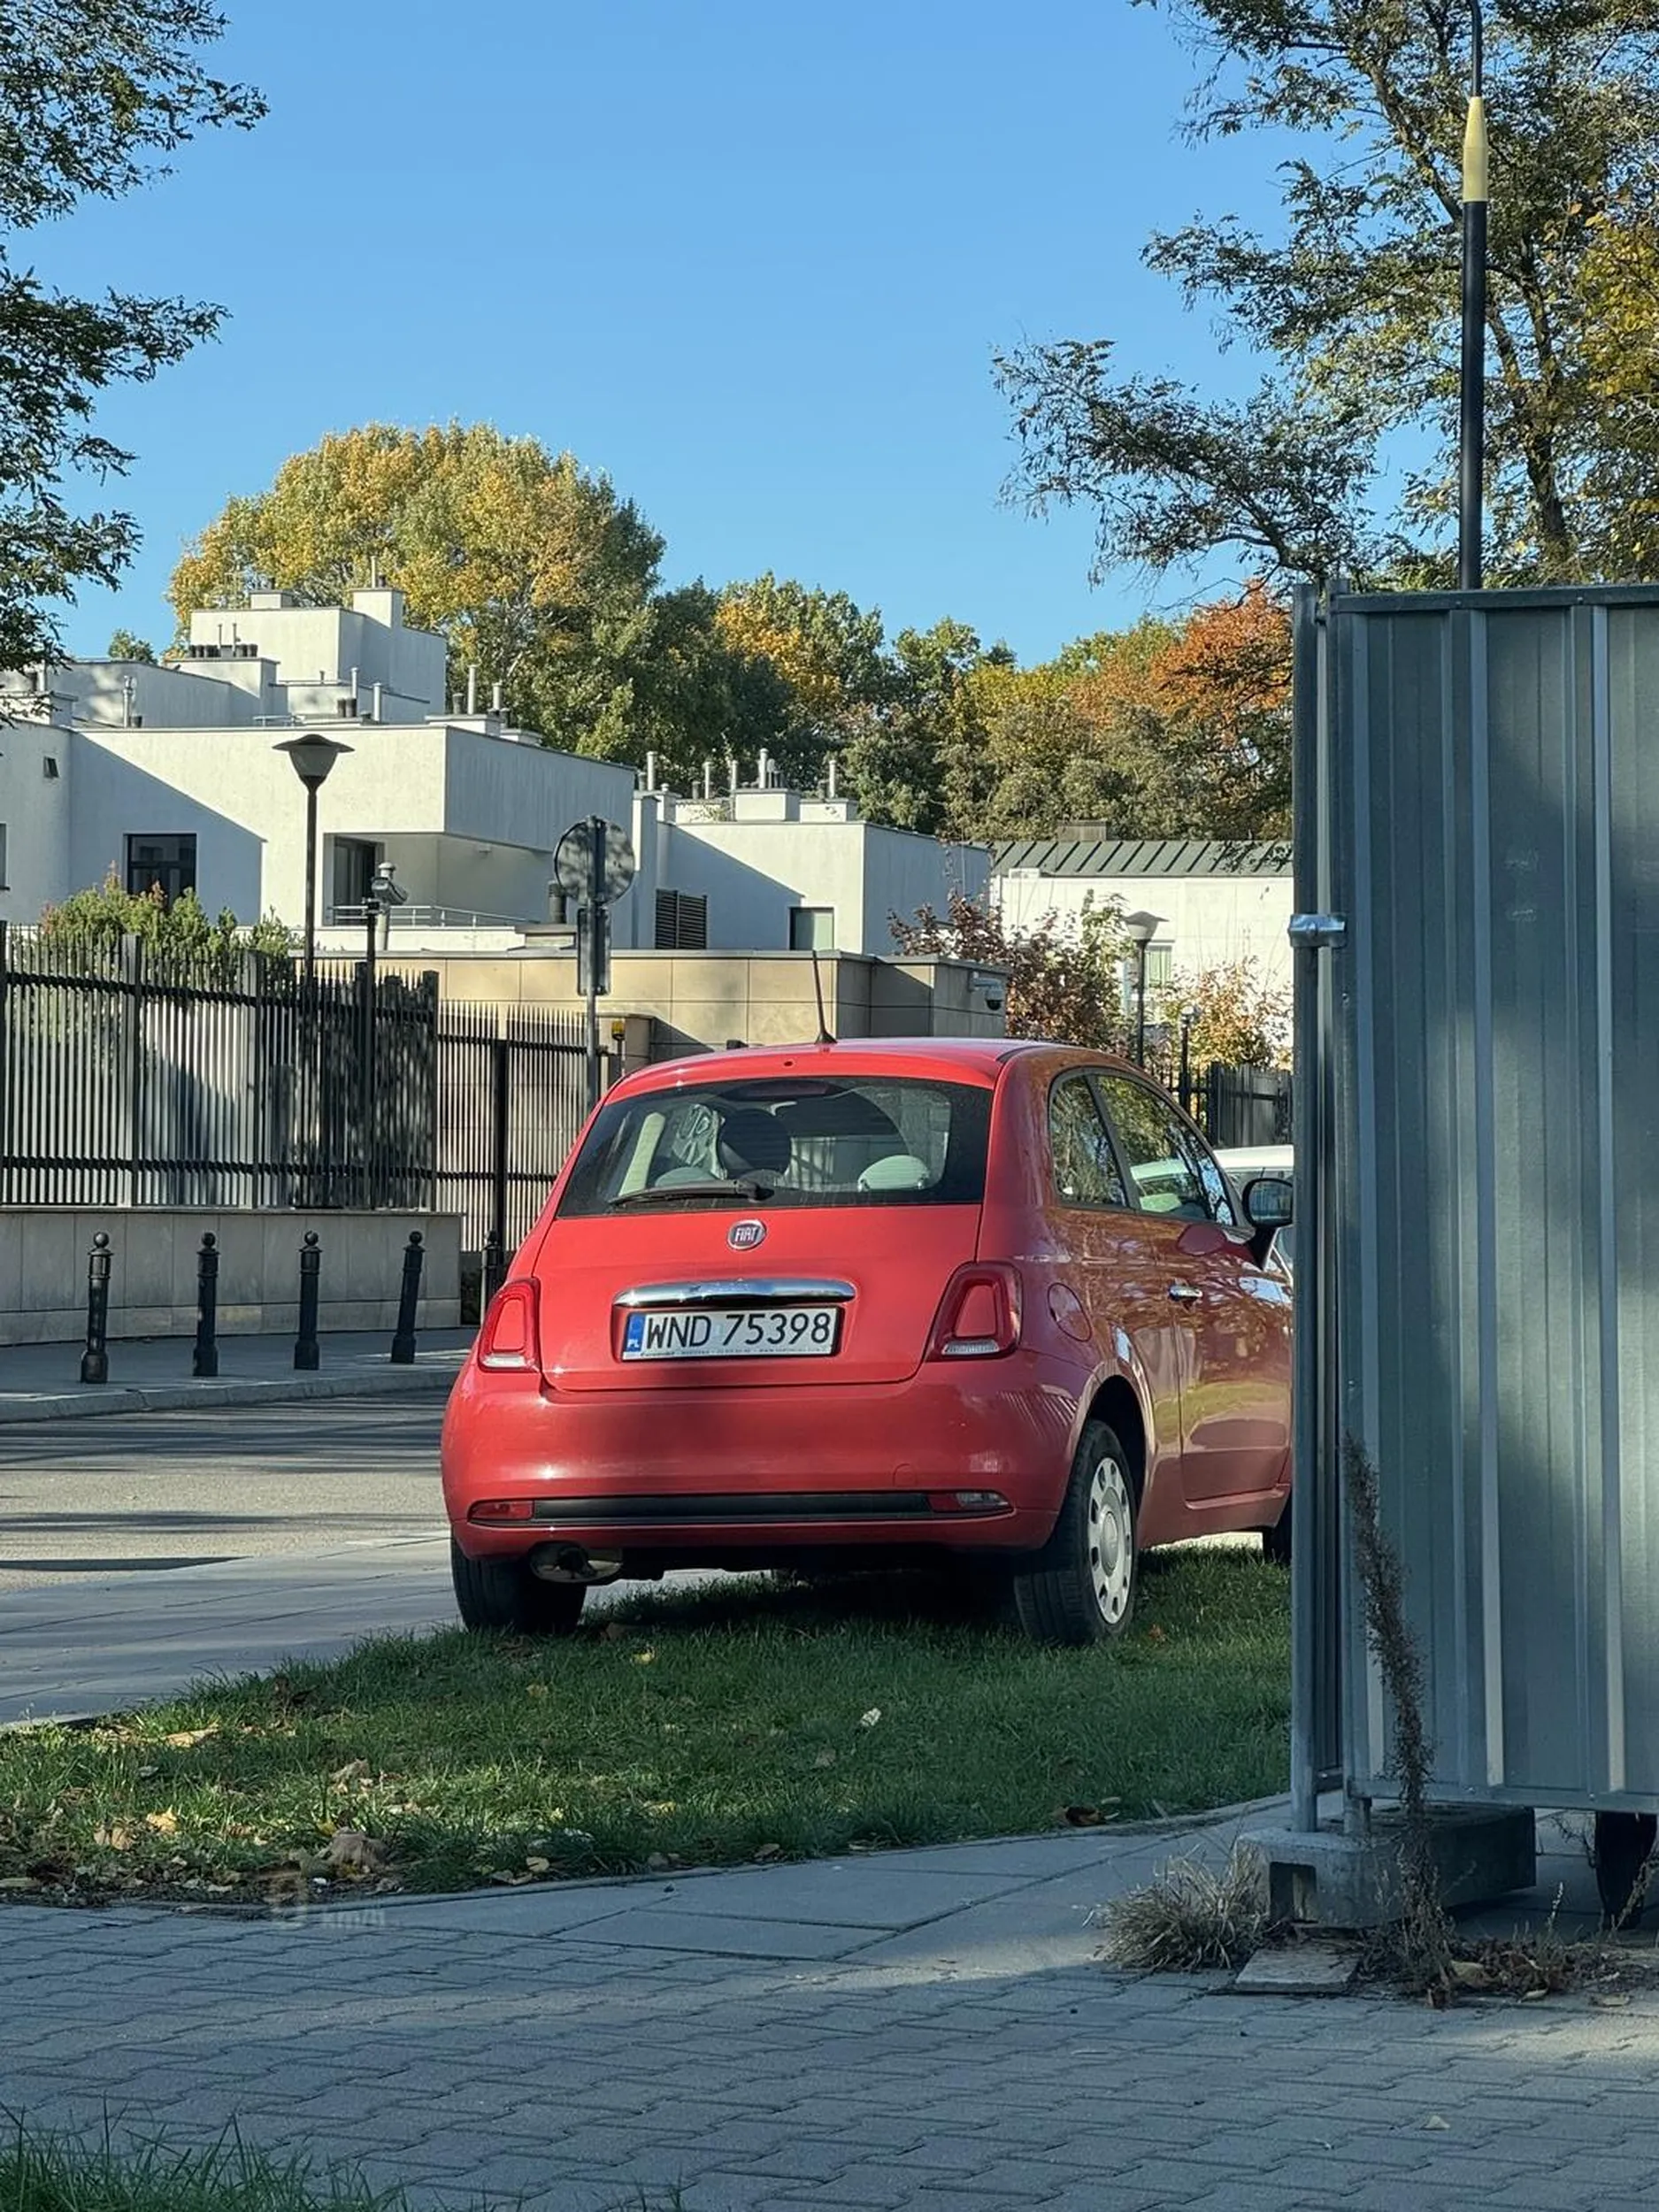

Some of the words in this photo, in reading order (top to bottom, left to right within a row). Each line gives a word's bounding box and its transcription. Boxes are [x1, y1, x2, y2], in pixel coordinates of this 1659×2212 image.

[734, 1226, 757, 1242] FIAT
[647, 1316, 711, 1349] WND
[723, 1313, 831, 1346] 75398
[627, 1339, 640, 1348] PL
